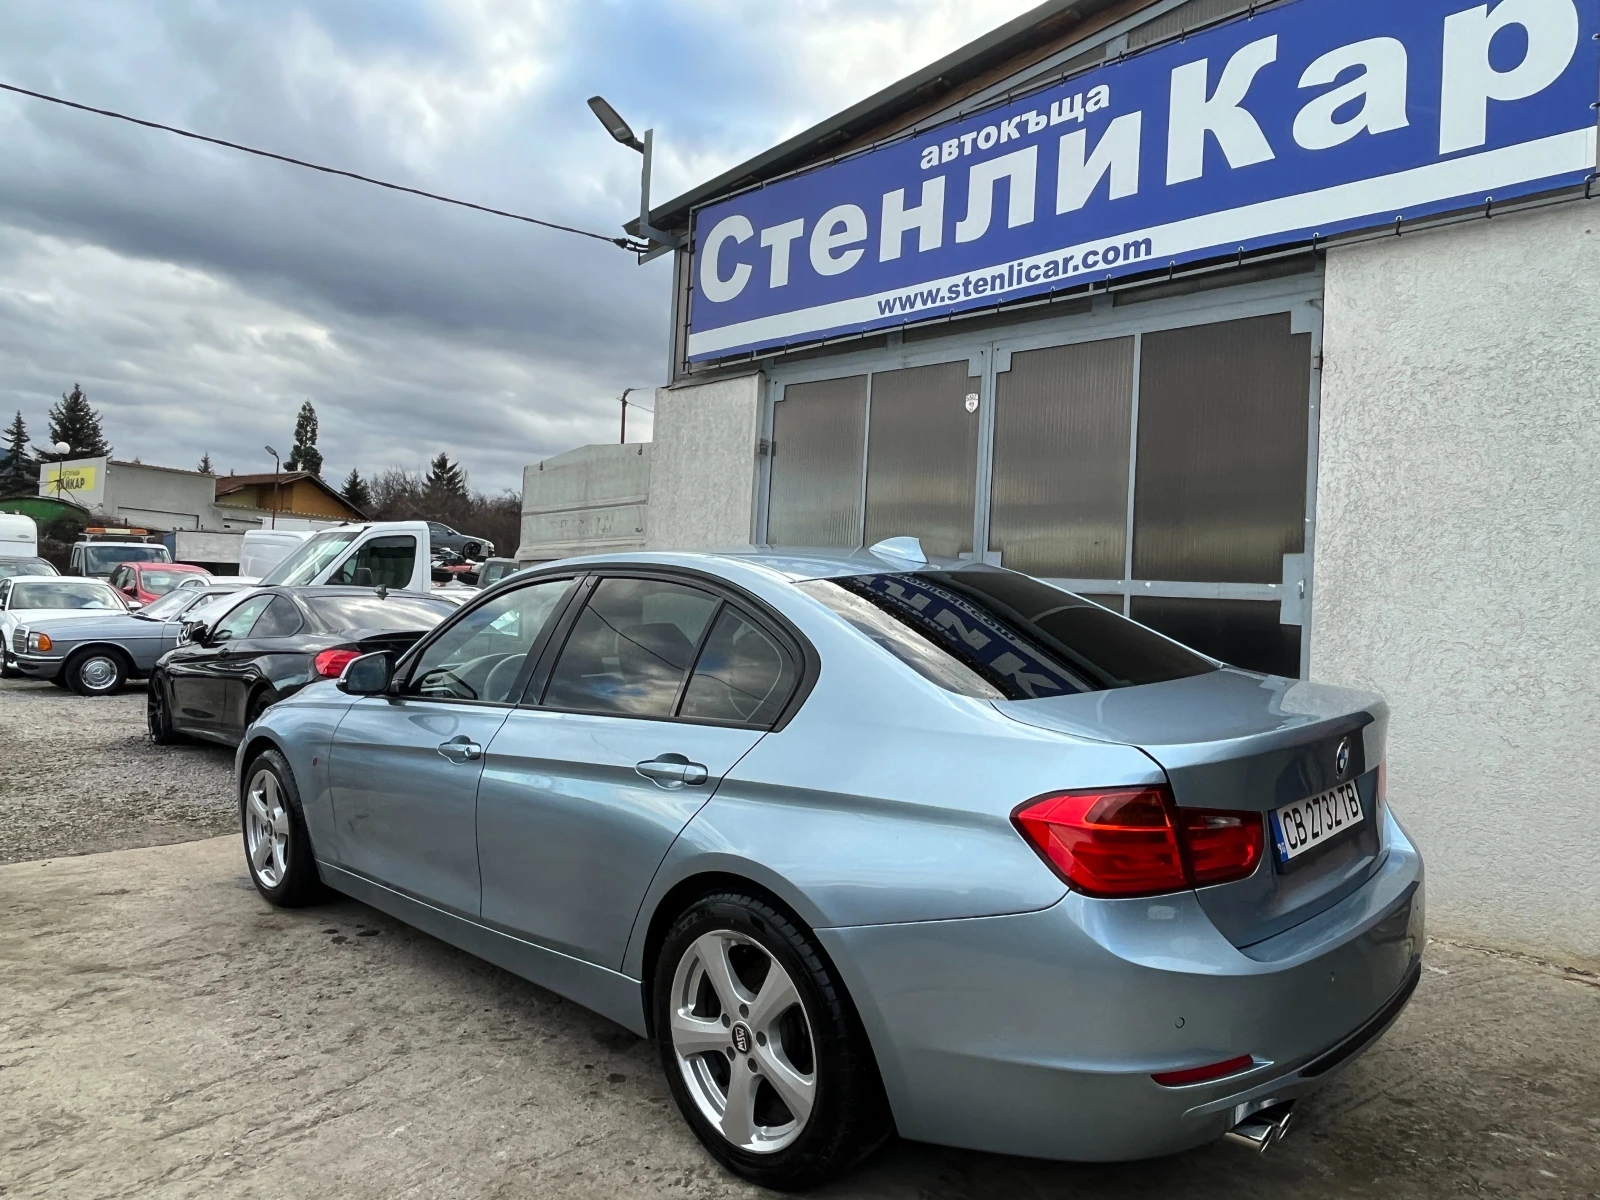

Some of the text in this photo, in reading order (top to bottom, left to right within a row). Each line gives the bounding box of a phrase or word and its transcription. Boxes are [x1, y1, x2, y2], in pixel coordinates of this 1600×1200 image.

[920, 84, 1110, 170] автокъща
[877, 237, 1152, 316] www.stenlicar.com
[1283, 783, 1359, 850] CB 2732 TB
